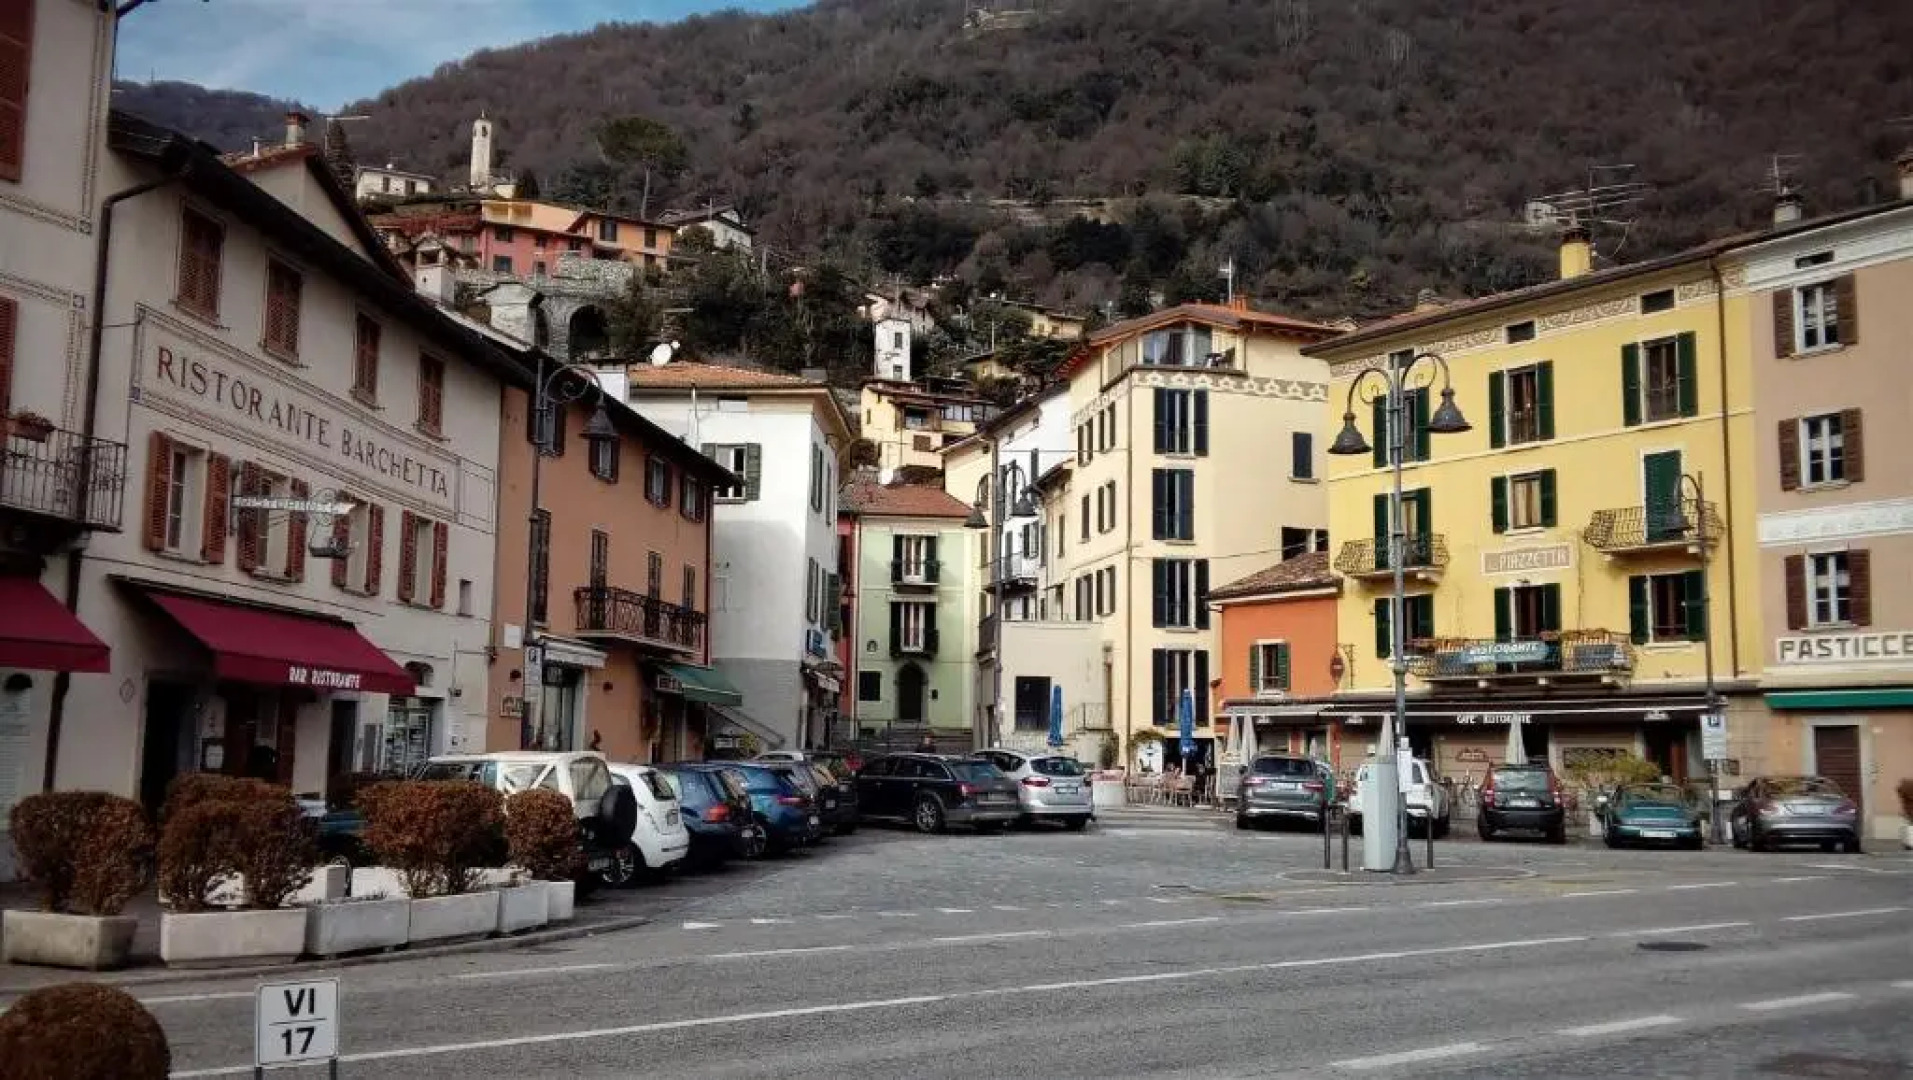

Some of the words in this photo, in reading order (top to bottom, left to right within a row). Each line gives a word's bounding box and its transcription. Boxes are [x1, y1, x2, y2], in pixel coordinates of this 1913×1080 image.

[157, 346, 331, 448] RISTORANTE
[341, 428, 448, 498] BARCHETTA
[1780, 634, 1913, 660] PASTICCE
[284, 988, 315, 1016] VI
[281, 1026, 316, 1055] 17
